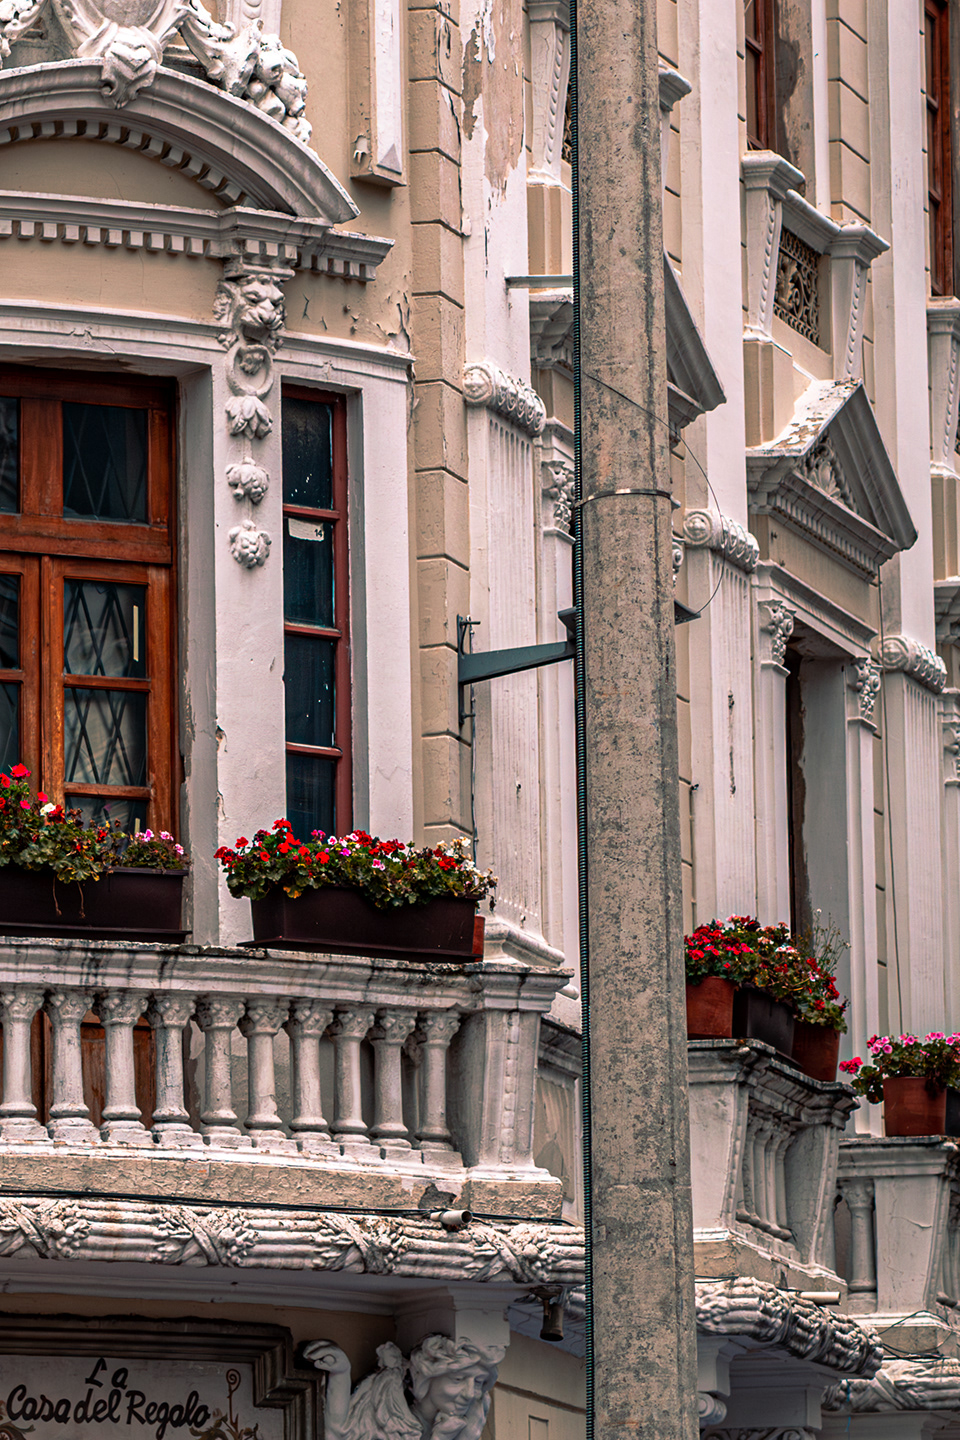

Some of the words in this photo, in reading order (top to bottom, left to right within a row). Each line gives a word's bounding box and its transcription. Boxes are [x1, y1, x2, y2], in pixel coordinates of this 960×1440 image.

[85, 1357, 129, 1391] La
[6, 1384, 72, 1425] Casa
[74, 1388, 121, 1424] del
[125, 1390, 211, 1440] Regalo
